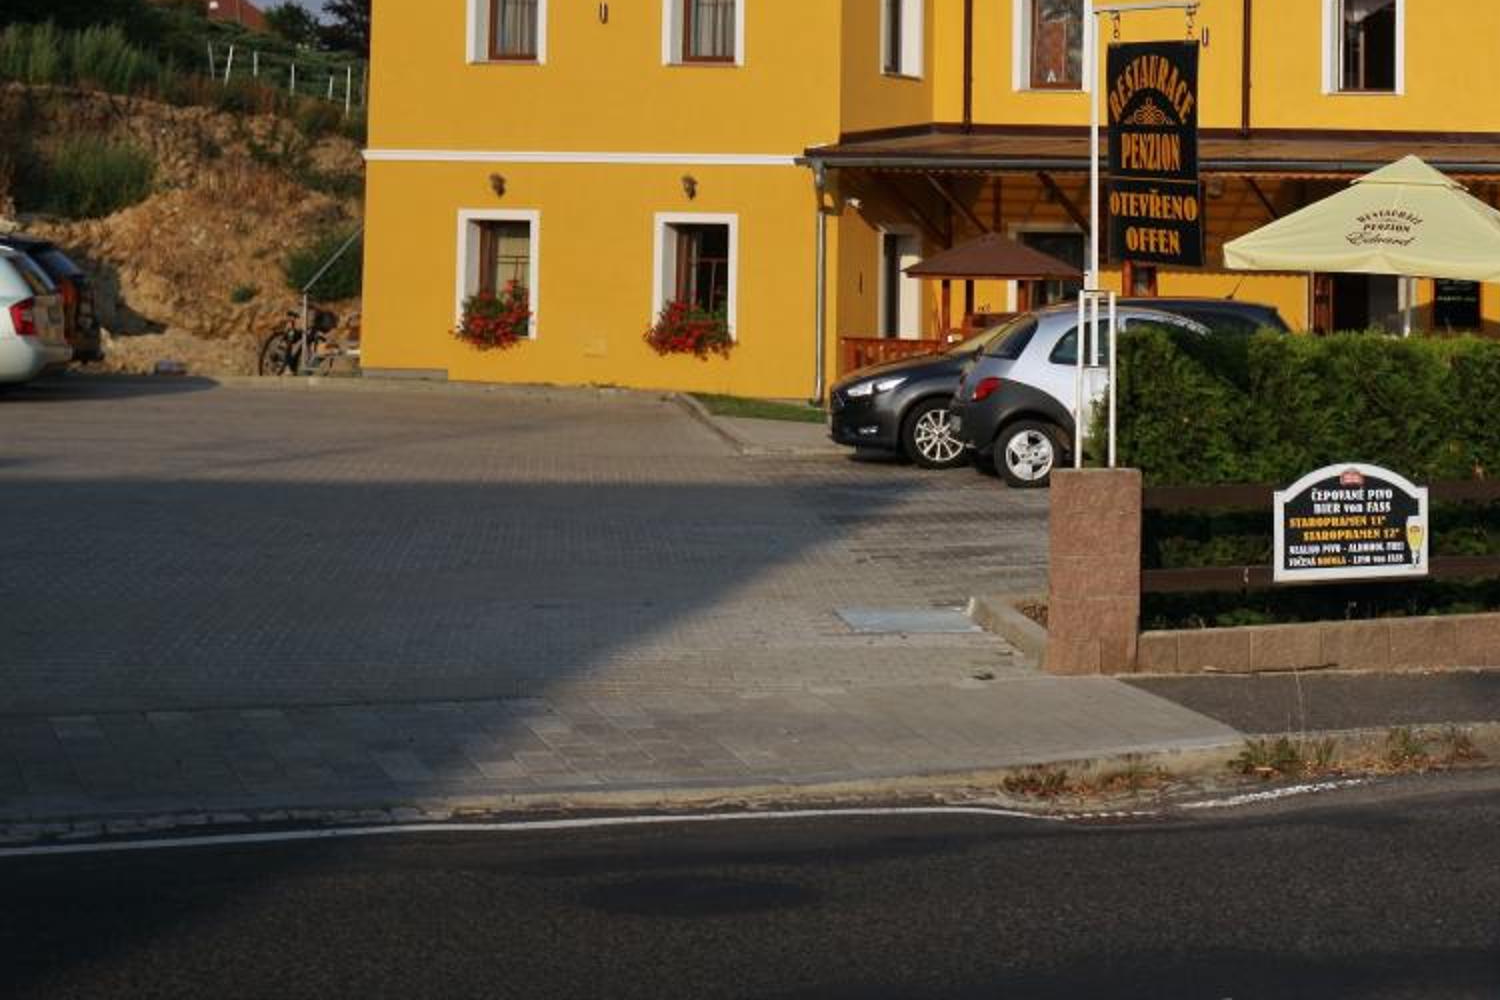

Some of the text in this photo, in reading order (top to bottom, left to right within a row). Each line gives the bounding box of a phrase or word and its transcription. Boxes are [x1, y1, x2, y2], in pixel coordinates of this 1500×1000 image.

[1109, 55, 1196, 124] RESTAURACE
[1121, 132, 1182, 171] PENZION
[1109, 189, 1198, 221] OTEVŘENO
[1125, 226, 1181, 254] OFFEN
[1367, 489, 1393, 500] PIVO
[1313, 502, 1341, 514] BIER
[1366, 501, 1392, 513] FASS
[1289, 516, 1367, 529] STAROPRAMEN
[1303, 529, 1381, 542] STAROPRAMEN
